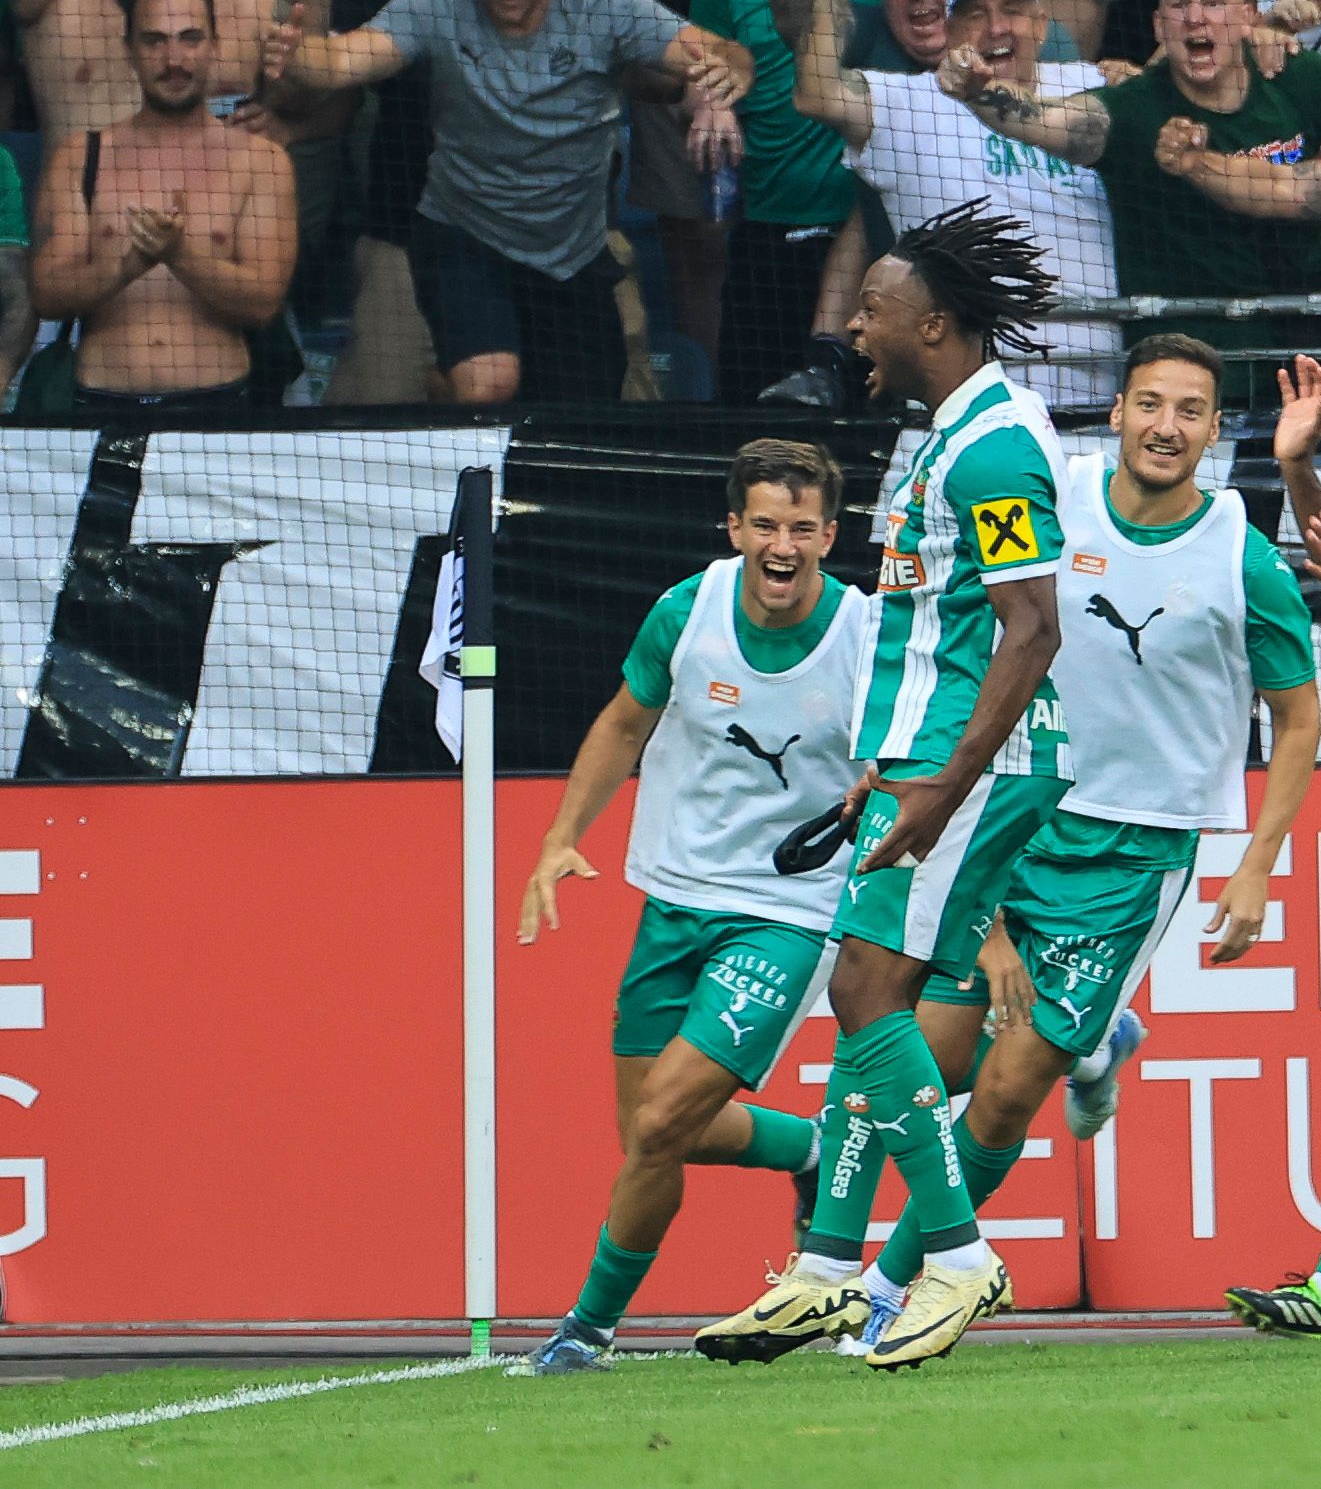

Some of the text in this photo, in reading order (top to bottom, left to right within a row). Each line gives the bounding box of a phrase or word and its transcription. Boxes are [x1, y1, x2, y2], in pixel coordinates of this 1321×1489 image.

[706, 963, 788, 1010] ZUCKER
[724, 954, 788, 986] WIENER
[829, 1115, 874, 1199] easystaff
[930, 1104, 962, 1188] easystaff
